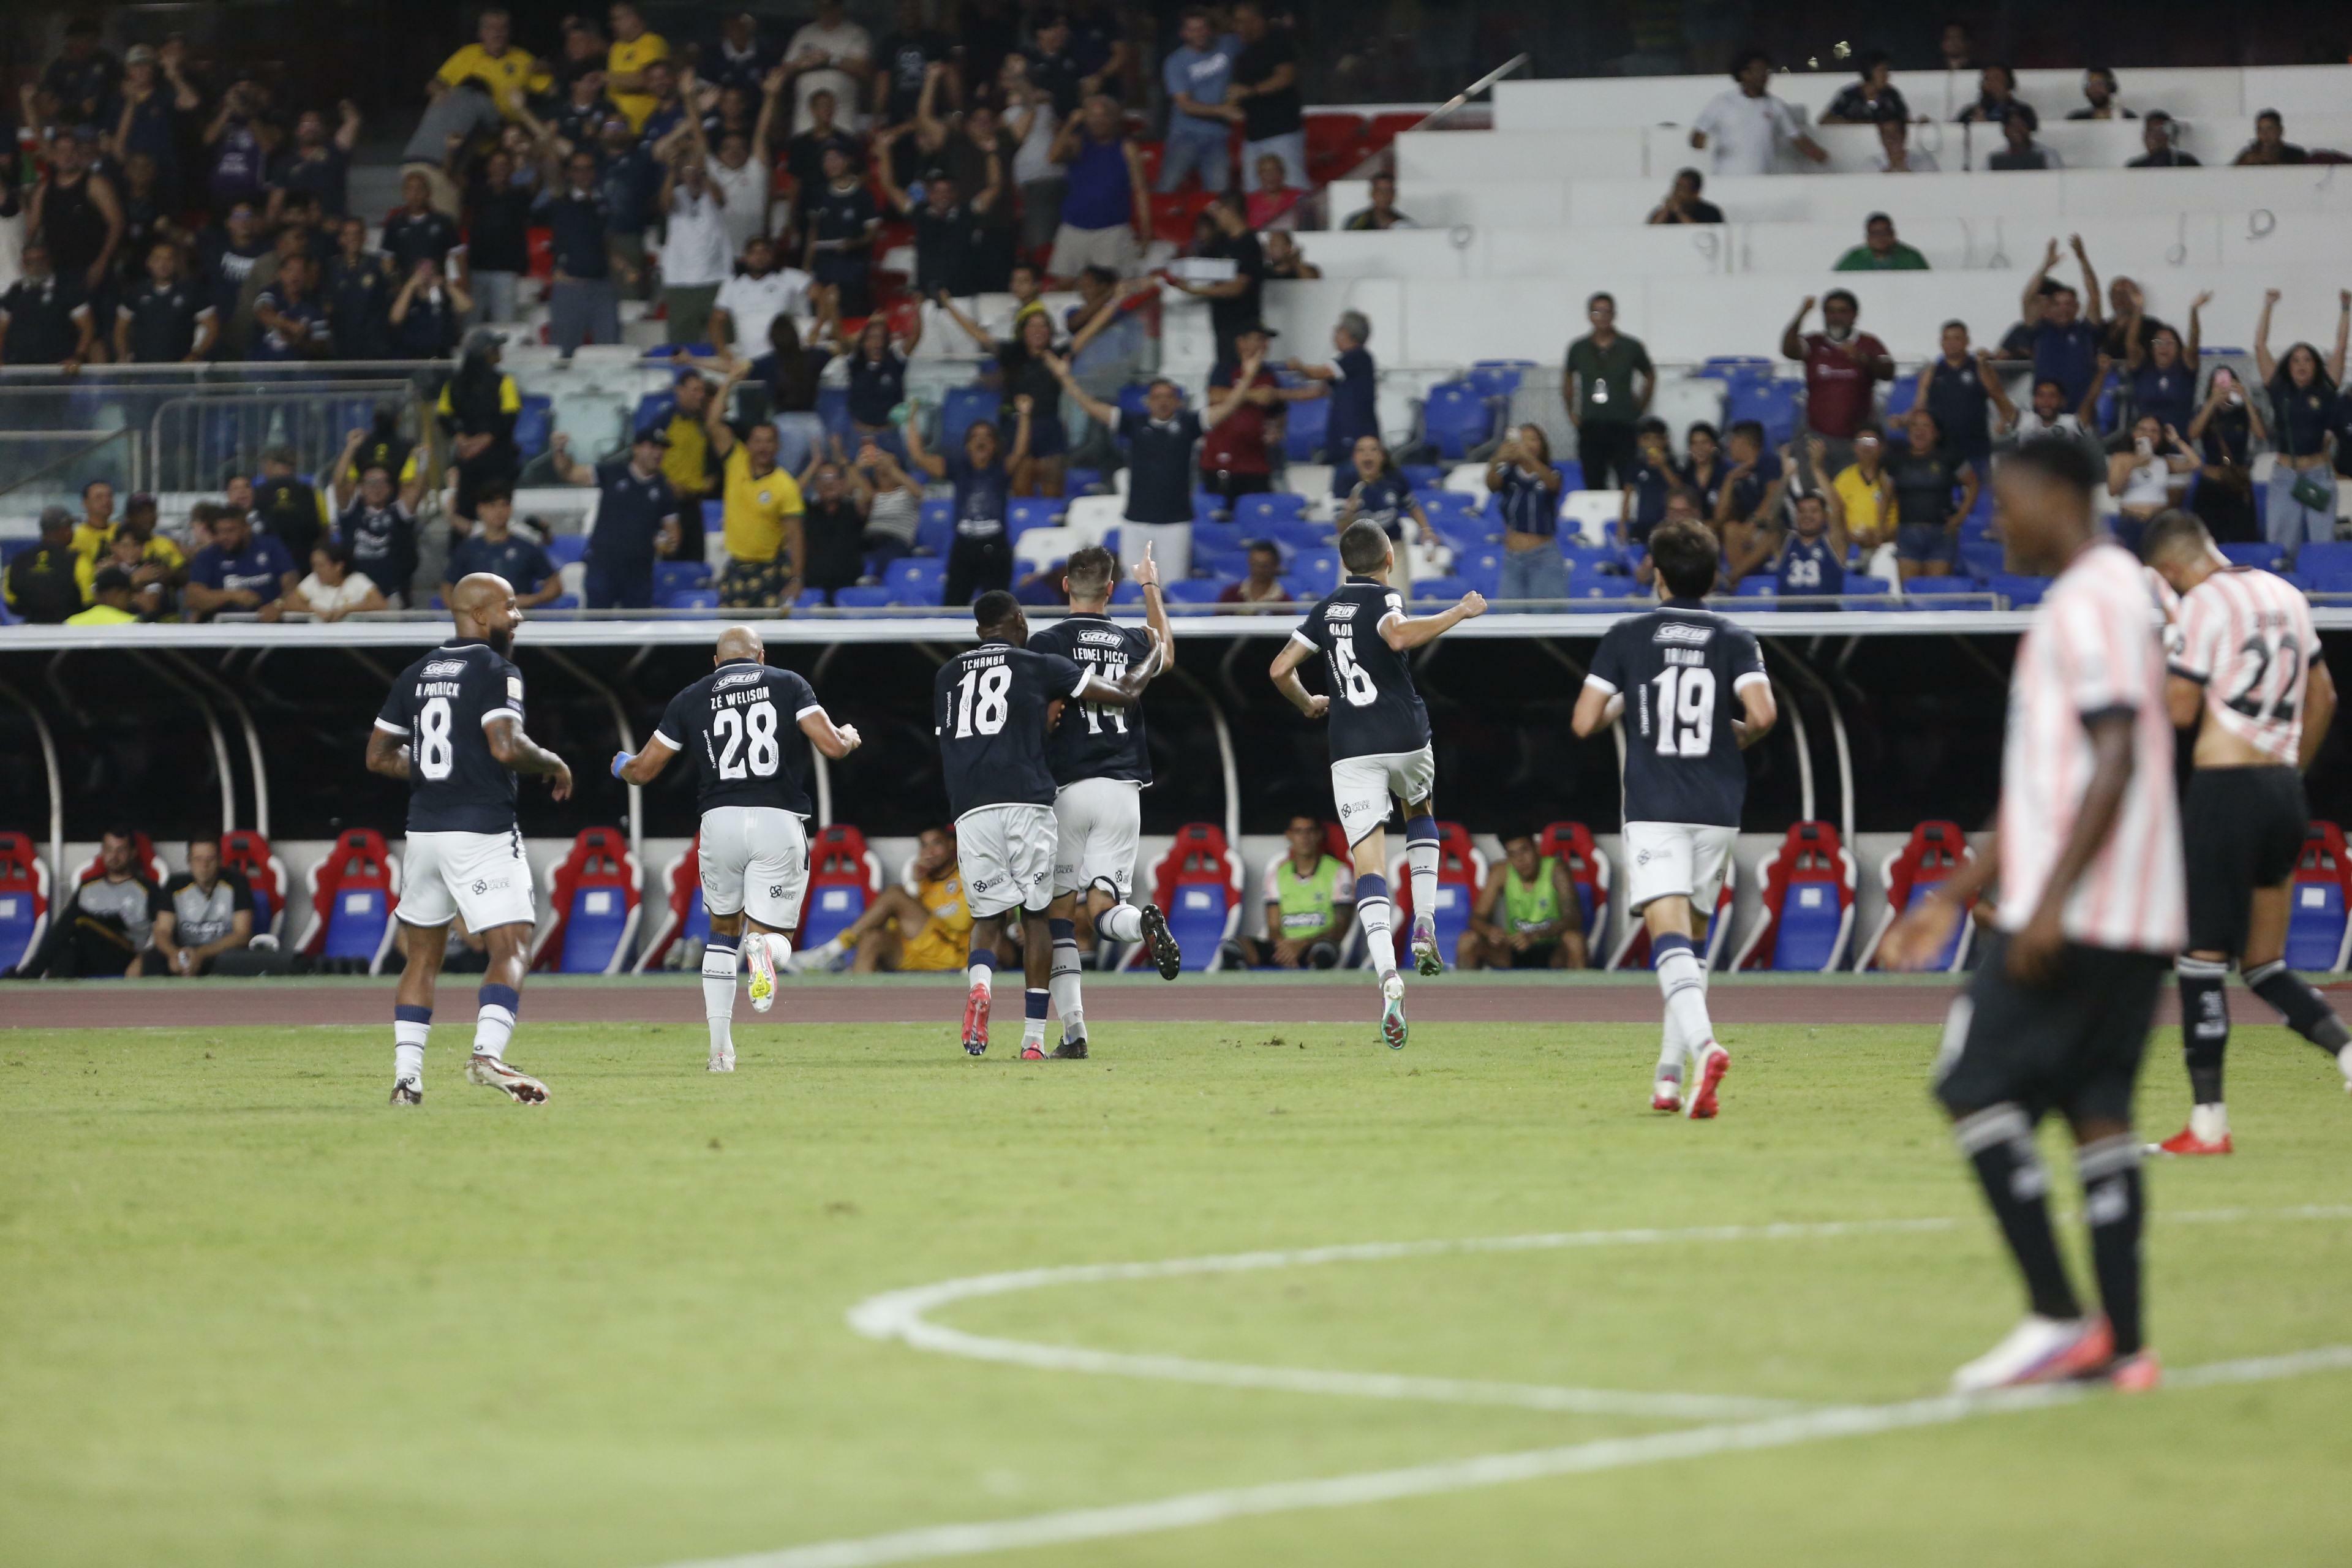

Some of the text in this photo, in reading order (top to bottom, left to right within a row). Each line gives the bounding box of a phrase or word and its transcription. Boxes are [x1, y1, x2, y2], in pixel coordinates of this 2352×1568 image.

[963, 655, 1005, 671] TCHAMBA
[1073, 648, 1101, 661] LEONEL
[1079, 630, 1123, 646] GAZIN
[1336, 638, 1378, 706] 6
[710, 686, 769, 709] ZÉ WELISON
[714, 671, 763, 690] GAZIN
[956, 665, 1012, 739] 18
[1652, 666, 1716, 756] 19
[2223, 633, 2300, 722] 22
[420, 697, 451, 778] 8
[714, 701, 778, 780] 28
